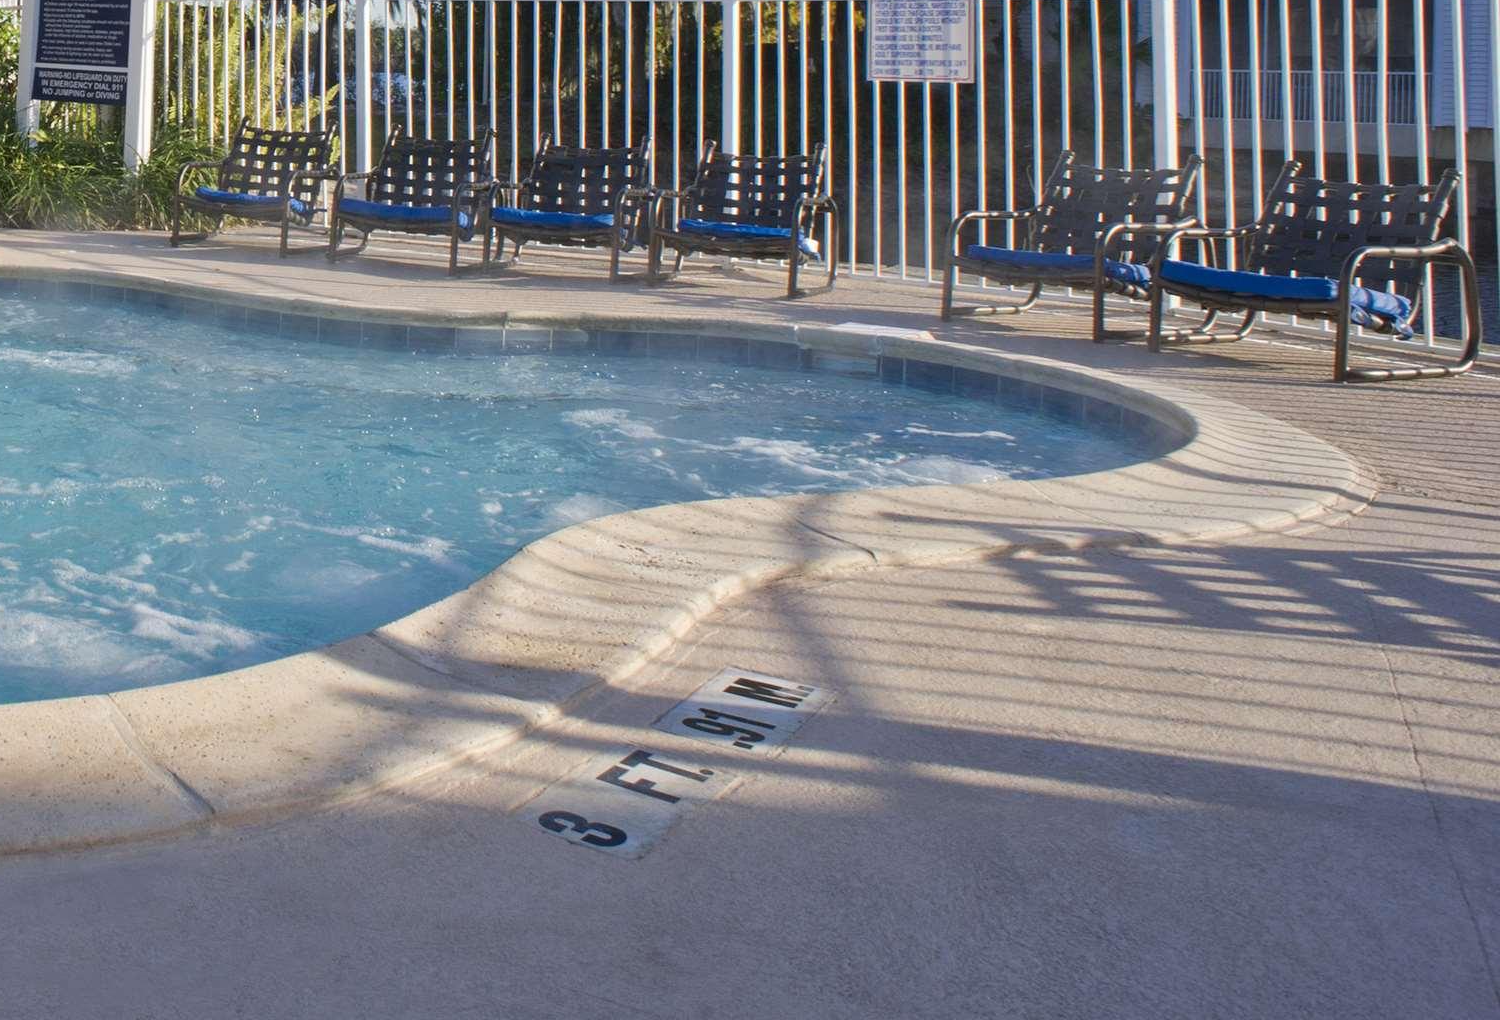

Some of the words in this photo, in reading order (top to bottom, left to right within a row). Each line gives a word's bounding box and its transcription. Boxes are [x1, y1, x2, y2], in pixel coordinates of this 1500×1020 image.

[72, 72, 102, 81] LIFEGUARD
[103, 74, 112, 82] ON
[113, 75, 128, 83] DUTY
[49, 79, 93, 89] EMERGENCY
[94, 82, 111, 90] DIAL
[112, 83, 123, 91] 911
[42, 87, 53, 95] NO
[54, 88, 86, 97] JUMPING
[95, 90, 120, 99] DIVING
[538, 810, 628, 847] 3
[595, 749, 714, 804] FT.
[681, 707, 777, 750] .91
